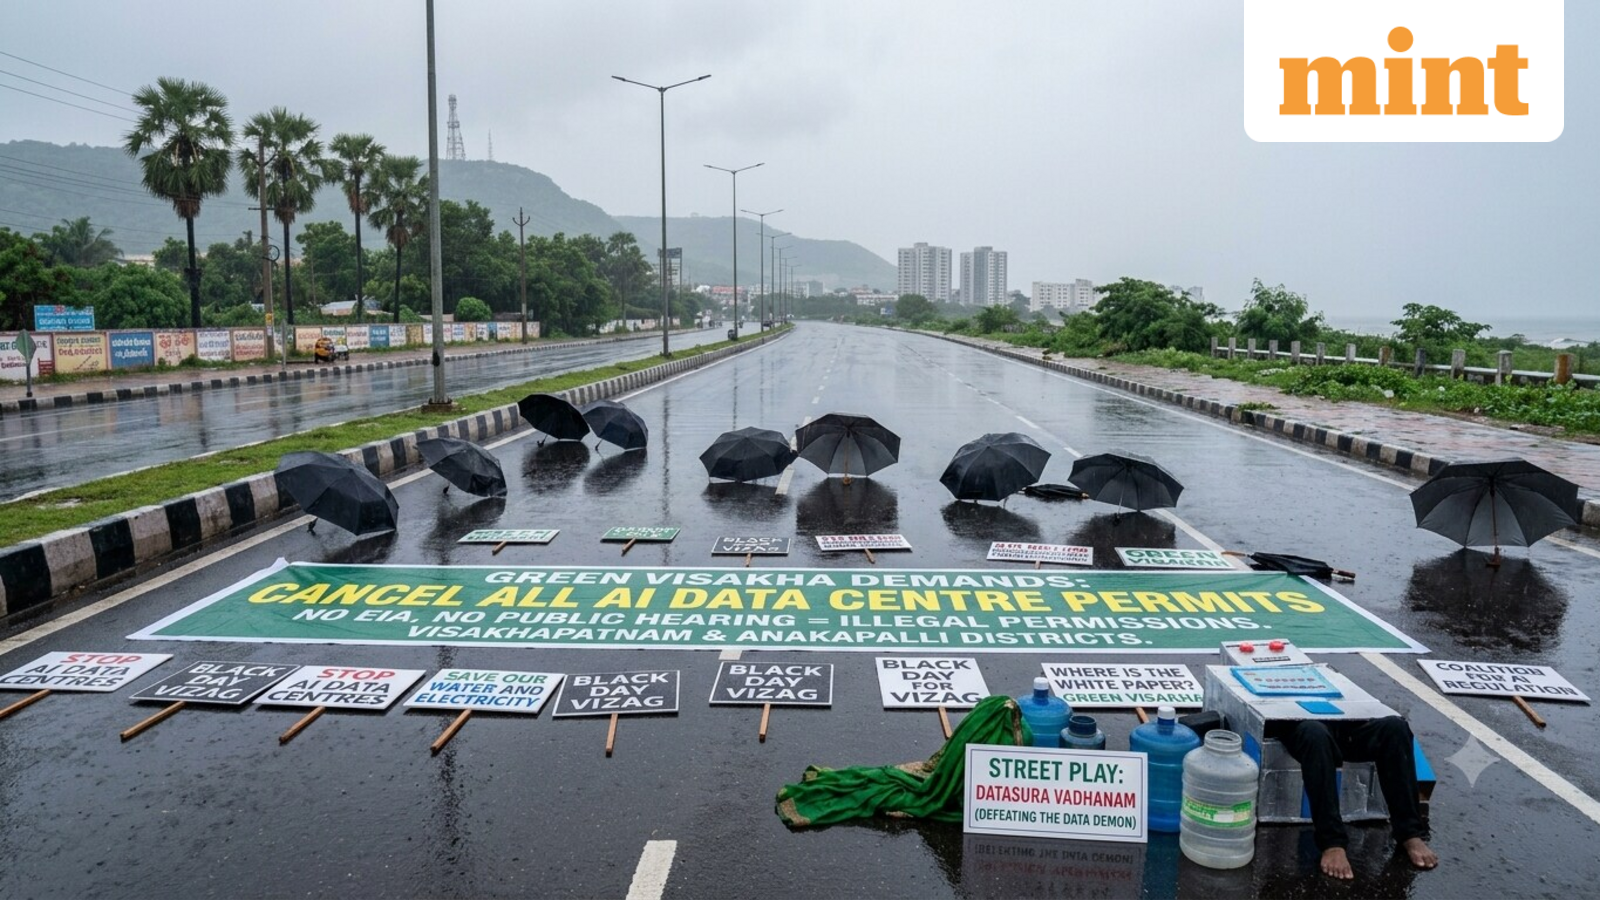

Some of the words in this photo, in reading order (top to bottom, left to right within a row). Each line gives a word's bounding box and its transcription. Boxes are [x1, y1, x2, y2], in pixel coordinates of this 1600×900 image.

[1125, 550, 1218, 559] GREEN
[485, 572, 632, 586] GREEN
[647, 572, 836, 587] VISAKHA
[851, 574, 1090, 589] DEMANDS:
[248, 582, 466, 607] CANCEL
[475, 585, 580, 608] ALL
[599, 587, 655, 609] AI
[671, 588, 810, 611] DATA
[829, 590, 1052, 613] CENTRE
[1062, 590, 1325, 614] PERMITS
[292, 608, 349, 622] NO
[355, 609, 420, 624] EIA,
[425, 610, 488, 624] NO
[494, 610, 625, 625] PUBLIC
[635, 613, 796, 627] HEARING
[808, 616, 829, 626] =
[840, 614, 990, 628] ILLEGAL
[998, 615, 1272, 630] PERMISSIONS.
[407, 624, 693, 641] VISAKHAPATNAM
[706, 630, 727, 643] &
[737, 629, 948, 644] ANAKAPALLI
[957, 631, 1153, 646] DISTRICTS.
[61, 653, 142, 666] STOP
[882, 659, 971, 670] BLACK
[25, 664, 59, 675] AI
[64, 665, 131, 676] DATA
[189, 663, 277, 678] BLACK
[317, 667, 396, 681] STOP
[729, 664, 822, 677] BLACK
[902, 671, 956, 682] DAY
[1050, 667, 1118, 678] WHERE
[1122, 668, 1143, 677] IS
[1148, 668, 1185, 678] THE
[0, 675, 123, 687] CENTRES
[184, 675, 240, 688] DAY
[444, 670, 500, 682] SAVE
[505, 673, 549, 685] OUR
[573, 672, 669, 688] BLACK
[744, 676, 803, 688] DAY
[1054, 679, 1119, 690] WHITE
[1122, 680, 1195, 690] PAPER?
[154, 685, 241, 699] VIZAG
[290, 679, 326, 690] AI
[329, 680, 391, 693] DATA
[429, 682, 497, 694] WATER
[500, 685, 544, 696] AND
[589, 684, 651, 698] DAY
[912, 682, 954, 691] FOR
[267, 690, 388, 705] CENTRES
[414, 692, 540, 708] ELECTRICITY
[726, 687, 818, 701] VIZAG
[890, 692, 985, 704] VIZAG
[1063, 693, 1122, 703] GREEN
[570, 696, 664, 711] VIZAG
[989, 757, 1063, 781] STREET
[1069, 762, 1124, 784] PLAY:
[976, 785, 1050, 804] DATASURA
[1054, 789, 1136, 809] VADHANAM
[974, 808, 1037, 824] (DEFEATING
[1040, 812, 1060, 824] THE
[1064, 813, 1090, 826] DATA
[1093, 815, 1137, 830] DEMON)
